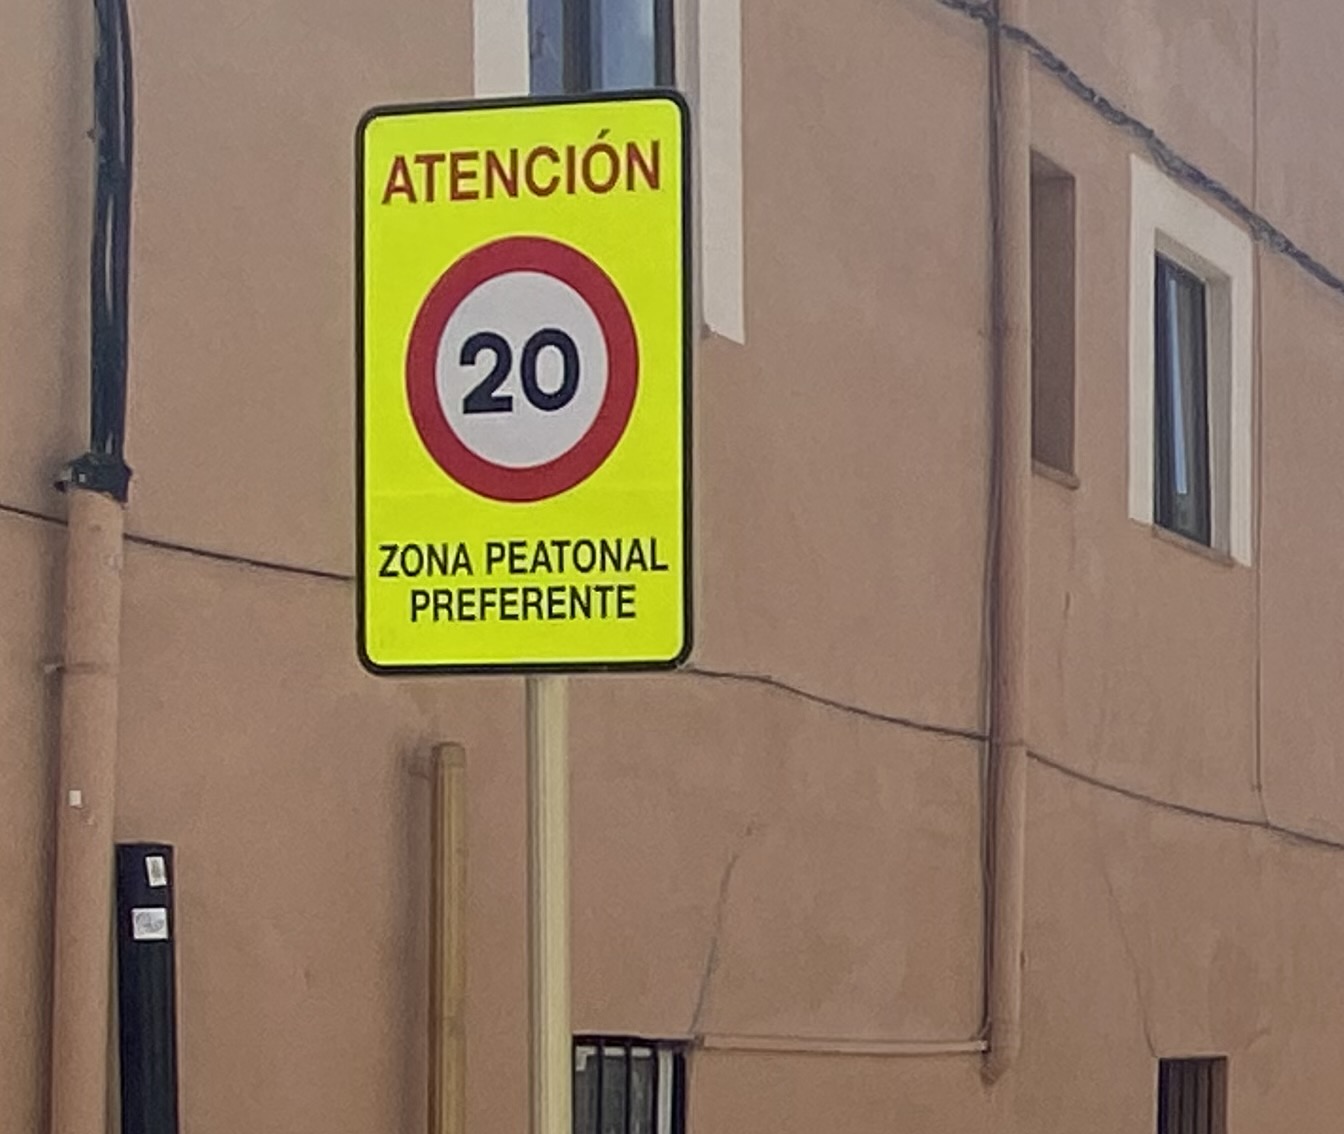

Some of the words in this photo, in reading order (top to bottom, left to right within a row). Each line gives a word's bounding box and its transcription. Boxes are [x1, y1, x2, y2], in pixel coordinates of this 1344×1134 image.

[382, 129, 661, 205] ATENCIÓN
[459, 329, 580, 414] 20
[379, 542, 474, 577] ZONA
[485, 537, 669, 575] PEATONAL
[410, 584, 637, 622] PREFERENTE
